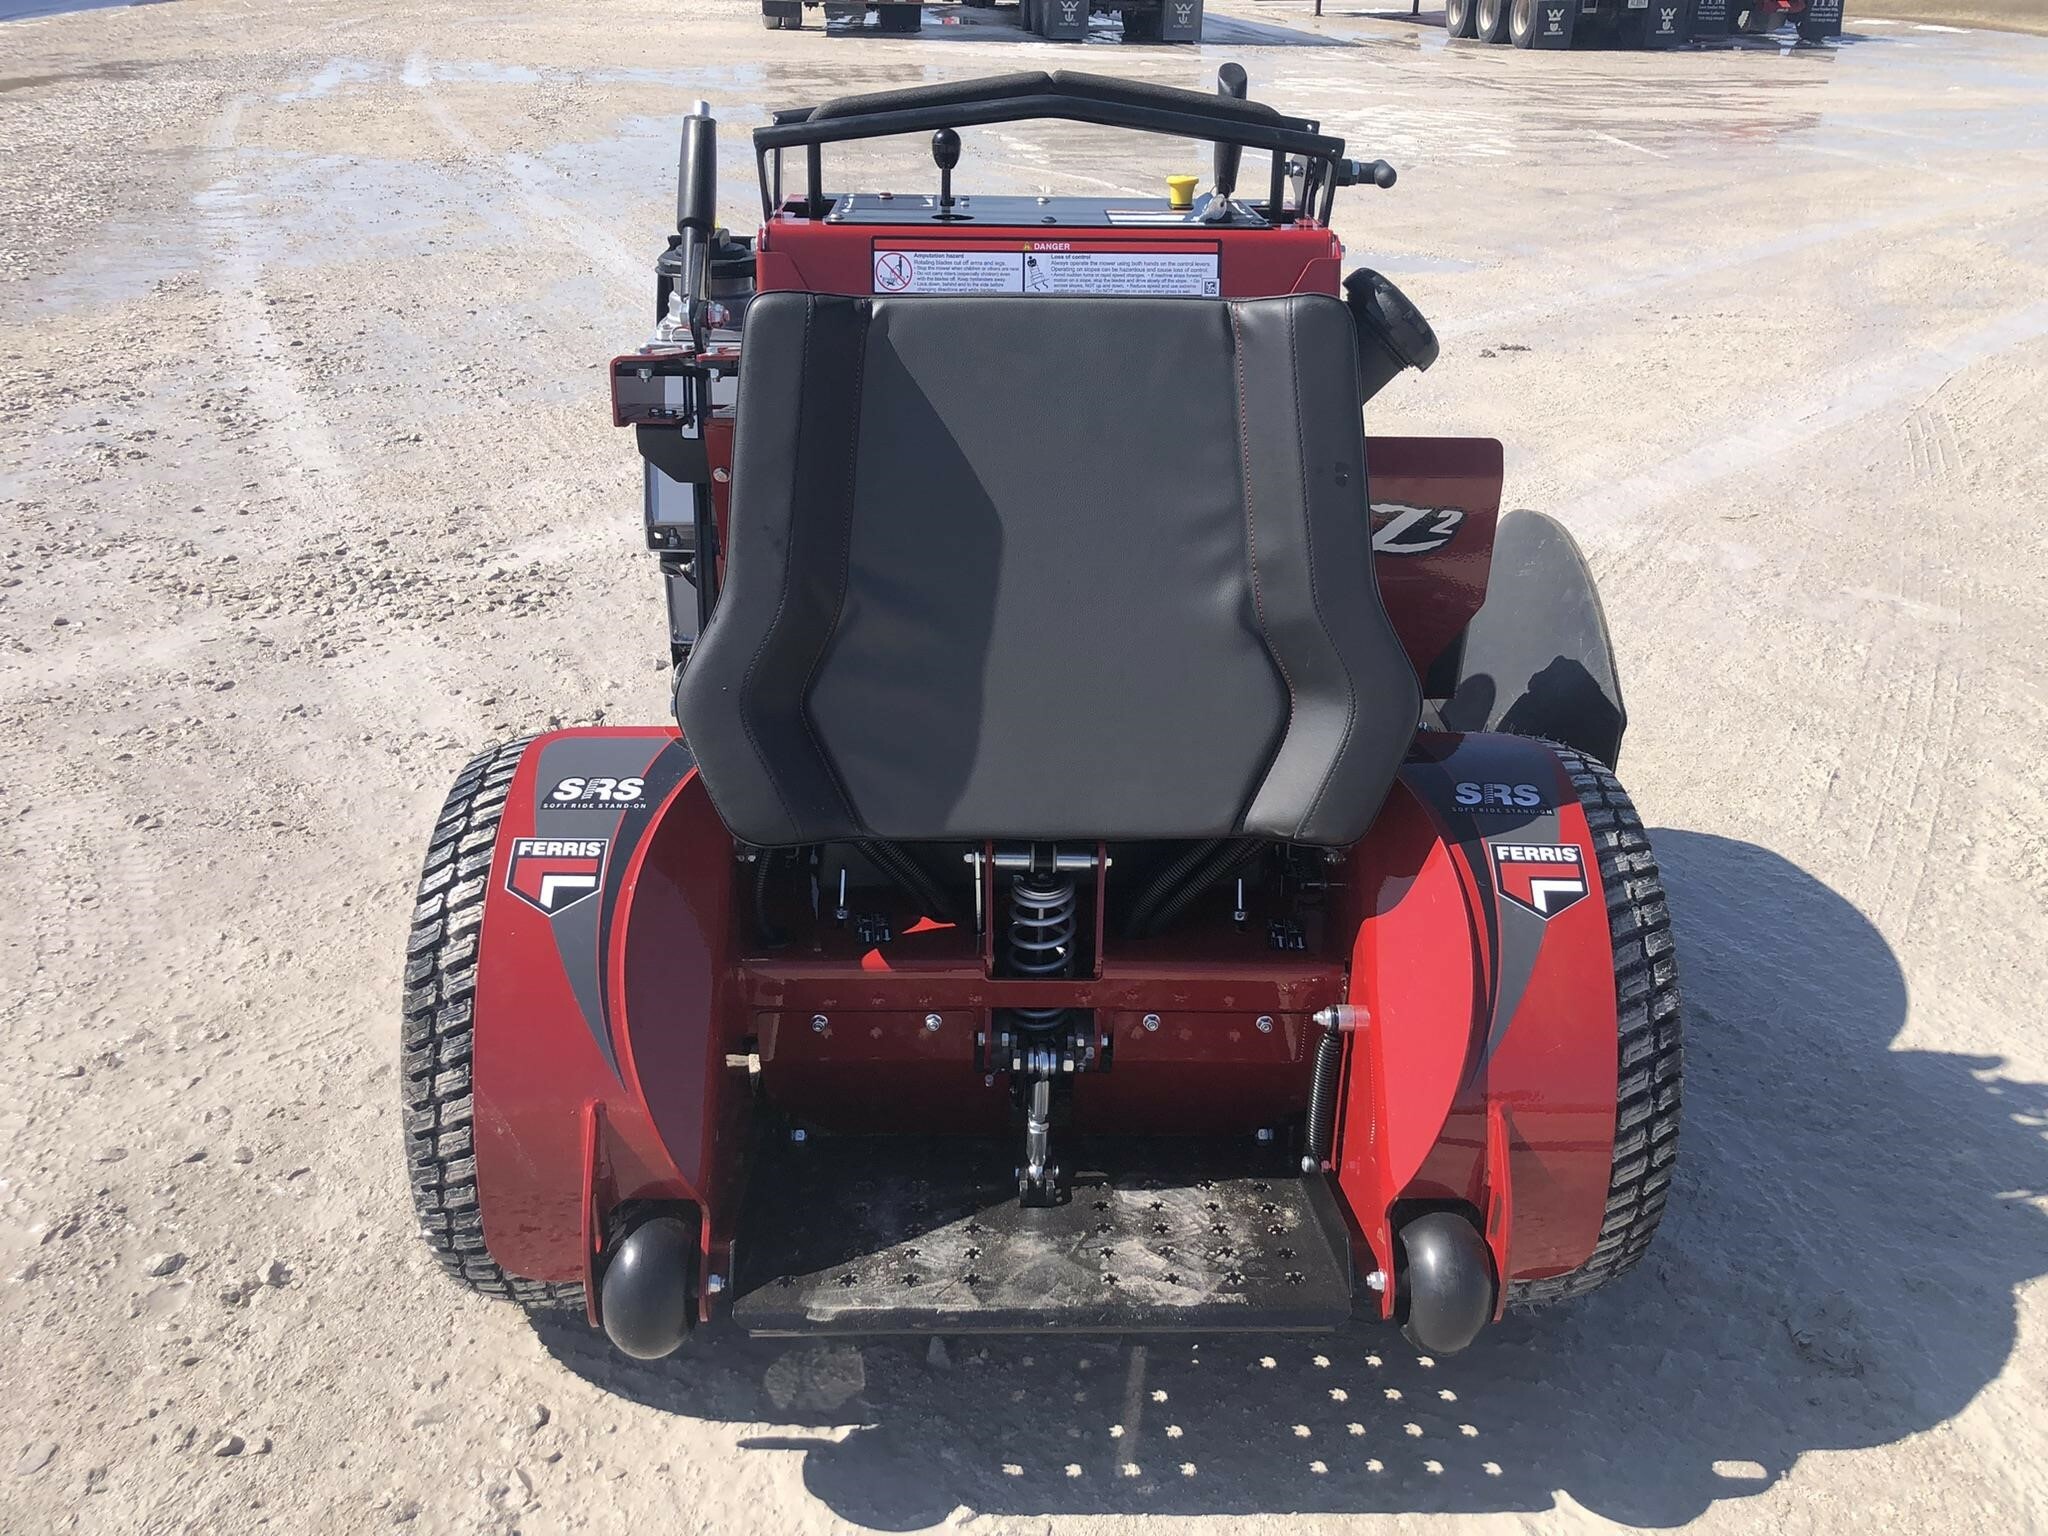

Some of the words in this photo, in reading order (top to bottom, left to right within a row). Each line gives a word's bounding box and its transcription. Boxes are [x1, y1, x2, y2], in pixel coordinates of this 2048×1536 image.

[553, 777, 645, 801] SRS
[1455, 782, 1540, 806] SRS
[518, 841, 601, 857] FERRIS
[1496, 846, 1577, 862] FERRIS
